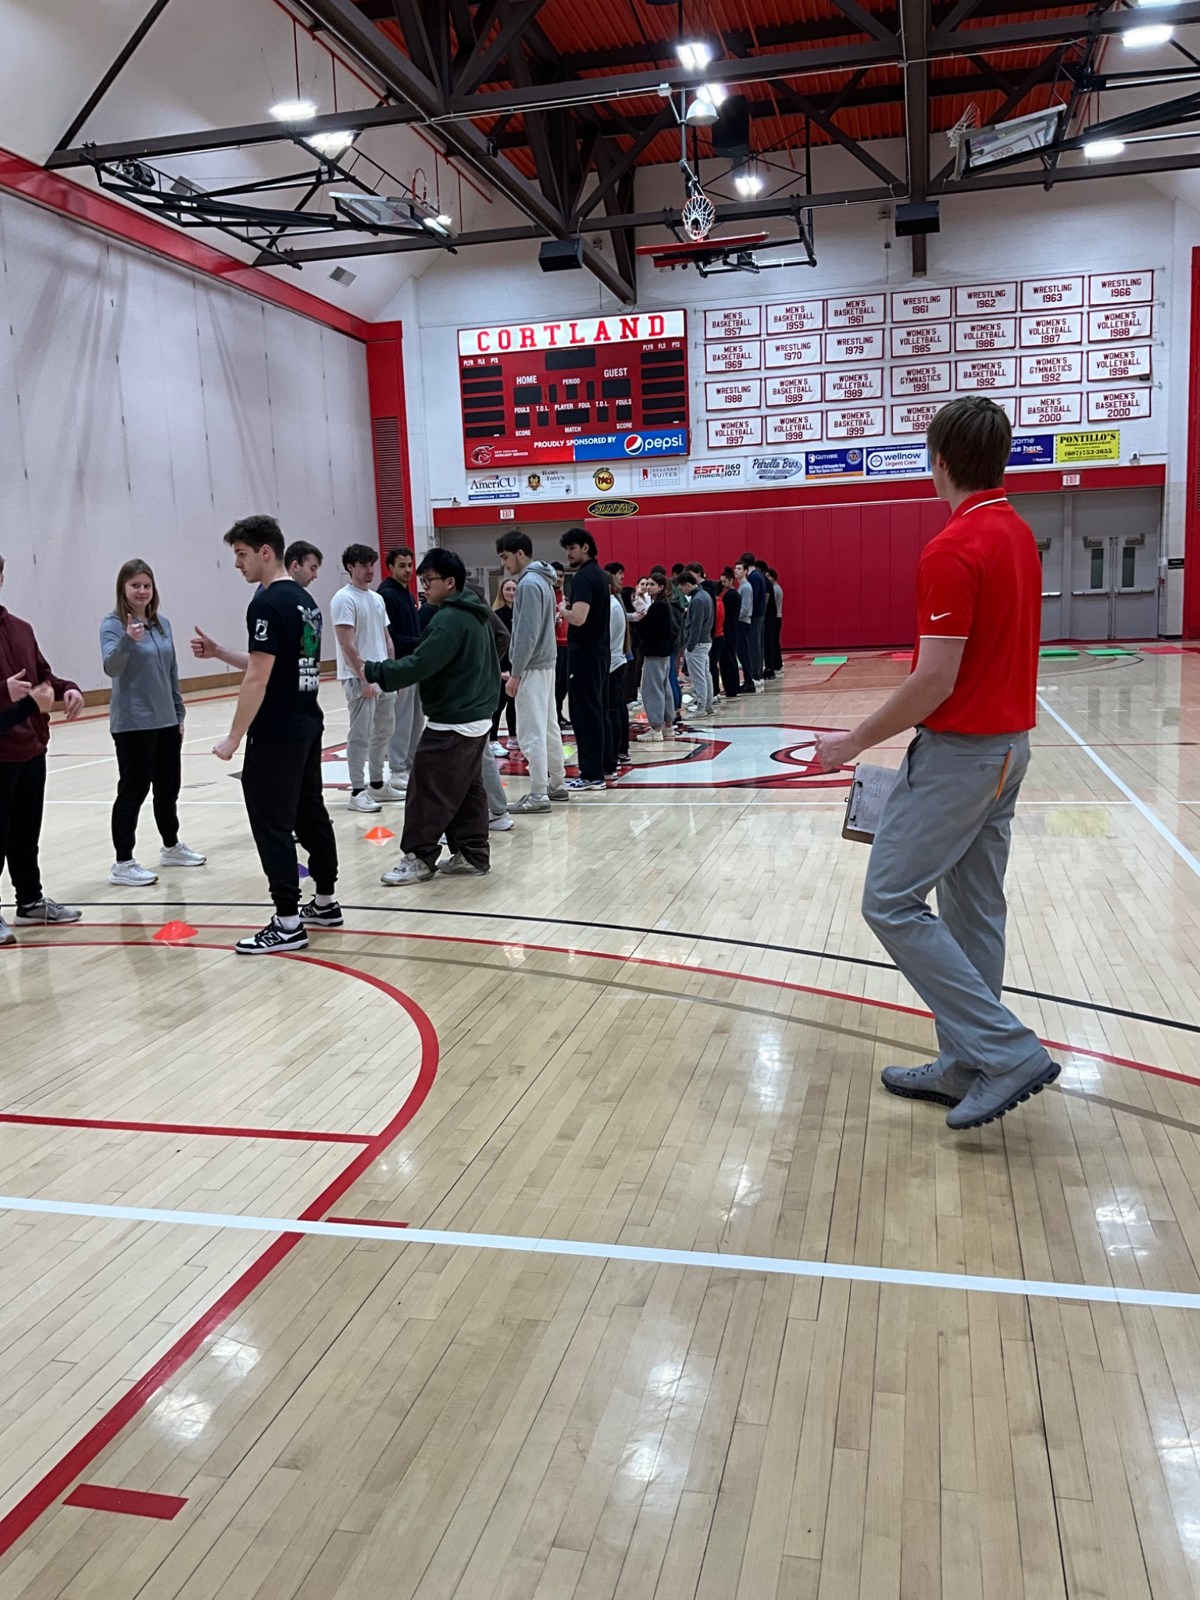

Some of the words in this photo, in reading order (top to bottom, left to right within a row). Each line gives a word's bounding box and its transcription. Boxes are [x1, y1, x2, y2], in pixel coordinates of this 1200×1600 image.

[1101, 278, 1141, 288] WRESTLING
[1033, 284, 1072, 294] WRESTLING
[1111, 288, 1131, 297] 1966
[968, 290, 1005, 299] WRESTLING
[1043, 293, 1062, 302] 1963
[903, 296, 940, 305] WRESTLING
[977, 299, 996, 308] 1962
[834, 306, 875, 317] BASKETBALL
[912, 306, 928, 314] 1961
[774, 313, 814, 323] BASKETBALL
[848, 316, 864, 324] 1961
[1104, 312, 1136, 321] WOMEN'S
[712, 319, 752, 328] BASKETBALL
[786, 321, 804, 329] 1959
[970, 323, 1001, 332] WOMEN'S
[1036, 319, 1066, 327] WOMEN'S
[1098, 319, 1142, 329] VOLLEYBALL
[477, 315, 664, 351] CORTLAND
[724, 328, 741, 336] 1957
[906, 328, 936, 337] WOMEN'S
[1029, 326, 1072, 335] VOLLEYBALL
[1110, 328, 1130, 337] 1988
[900, 335, 942, 345] VOLLEYBALL
[964, 331, 1006, 340] VOLLEYBALL
[1041, 335, 1060, 343] 1987
[837, 337, 873, 346] WRESTLING
[976, 340, 994, 348] 1986
[775, 342, 811, 351] WRESTLING
[845, 346, 864, 354] 1979
[912, 344, 930, 353] 1985
[713, 352, 752, 361] BASKETBALL
[784, 352, 802, 360] 1970
[1103, 351, 1135, 360] WOMEN'S
[725, 361, 742, 369] 1969
[1036, 357, 1067, 365] WOMEN'S
[1097, 358, 1141, 368] VOLLEYBALL
[971, 362, 1001, 371] WOMEN'S
[1030, 364, 1072, 374] GYMNASTICS
[1109, 367, 1129, 375] 1996
[604, 368, 628, 377] GUEST
[906, 367, 936, 376] WOMEN'S
[964, 370, 1006, 378] BASKETBALL
[516, 375, 537, 384] HOME
[839, 373, 868, 382] WOMEN'S
[901, 374, 941, 384] GYMNASTICS
[977, 378, 996, 386] 1992
[1041, 373, 1061, 382] 1992
[780, 378, 808, 387] WOMEN'S
[833, 381, 873, 390] VOLLEYBALL
[716, 386, 751, 394] WRESTLING
[773, 386, 813, 395] BASKETBALL
[844, 389, 862, 397] 1989
[725, 395, 742, 403] 1988
[785, 394, 802, 402] 1989
[1103, 392, 1135, 401] WOMEN'S
[1040, 398, 1061, 406] MEN'S
[1096, 399, 1140, 409] BASKETBALL
[907, 406, 936, 414] WOMEN'S
[1028, 405, 1071, 414] BASKETBALL
[1107, 408, 1130, 417] 2000
[841, 411, 870, 420] WOMEN'S
[900, 413, 935, 423] VOLLEYBA
[1039, 414, 1061, 422] 2000
[721, 421, 749, 429] WOMEN'S
[780, 416, 808, 425] WOMEN'S
[834, 418, 875, 428] BASKETBALL
[715, 427, 754, 437] VOLLEYBALL
[774, 423, 813, 432] VOLLEYBALL
[846, 427, 864, 435] 1999
[726, 436, 744, 444] 1997
[785, 432, 803, 440] 1998
[1060, 433, 1116, 444] PONTILLO'S
[534, 440, 564, 448] PROUDLY
[566, 437, 606, 446] SPONSORED
[645, 434, 682, 451] pepsi
[884, 452, 921, 460] wellnow
[752, 458, 780, 469] Petrella
[782, 458, 799, 468] Bros.
[694, 465, 724, 474] ESPN
[470, 476, 516, 489] AmeriCU
[1066, 476, 1077, 484] EXIT
[593, 503, 635, 513] SUNYAC
